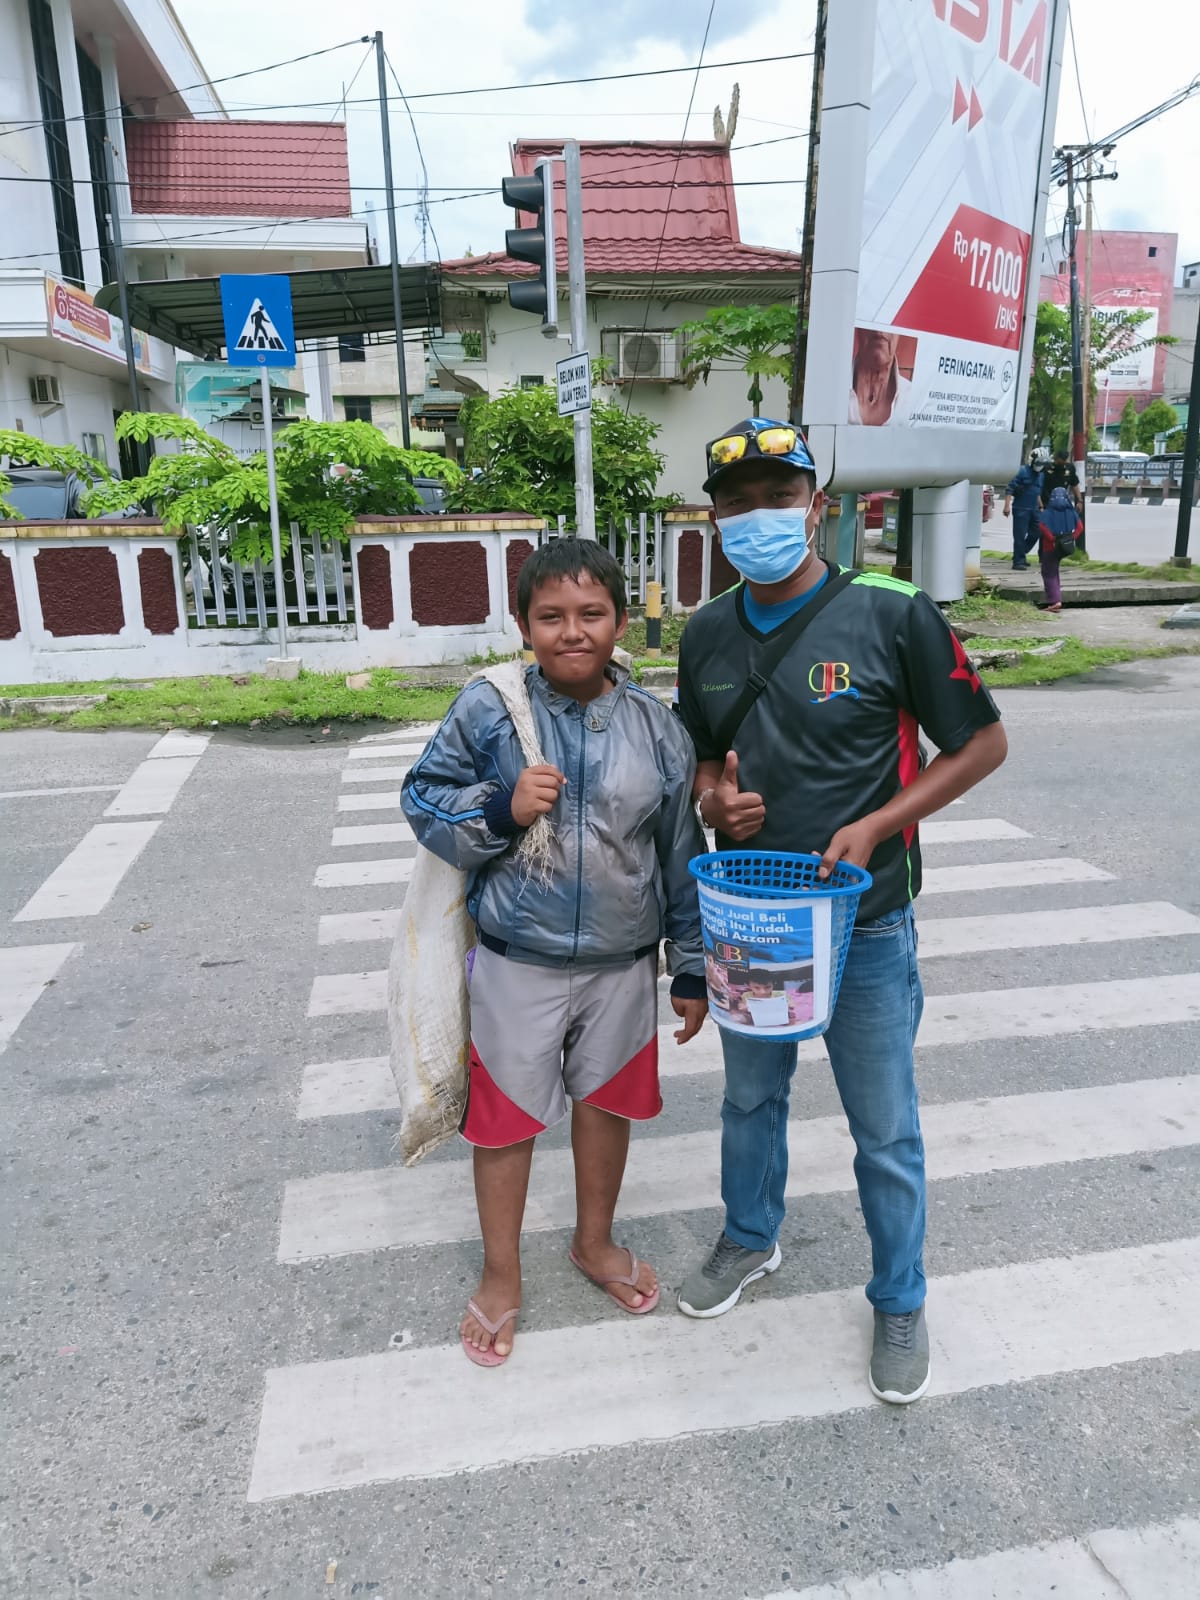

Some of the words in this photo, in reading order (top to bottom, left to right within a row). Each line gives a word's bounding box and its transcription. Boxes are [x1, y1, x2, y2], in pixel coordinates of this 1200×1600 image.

[931, 0, 1048, 87] STA
[953, 230, 969, 264] Rp
[970, 236, 1023, 301] 17.000
[994, 306, 1018, 332] /BKS
[560, 369, 575, 385] BELOK
[575, 365, 586, 381] KIRI
[938, 356, 996, 381] PERINGATAN:
[573, 385, 587, 400] TERUS
[727, 908, 754, 922] Jual
[759, 912, 786, 923] Beli
[730, 919, 747, 931] Itu
[751, 922, 794, 934] Indah
[732, 931, 780, 944] Azzam
